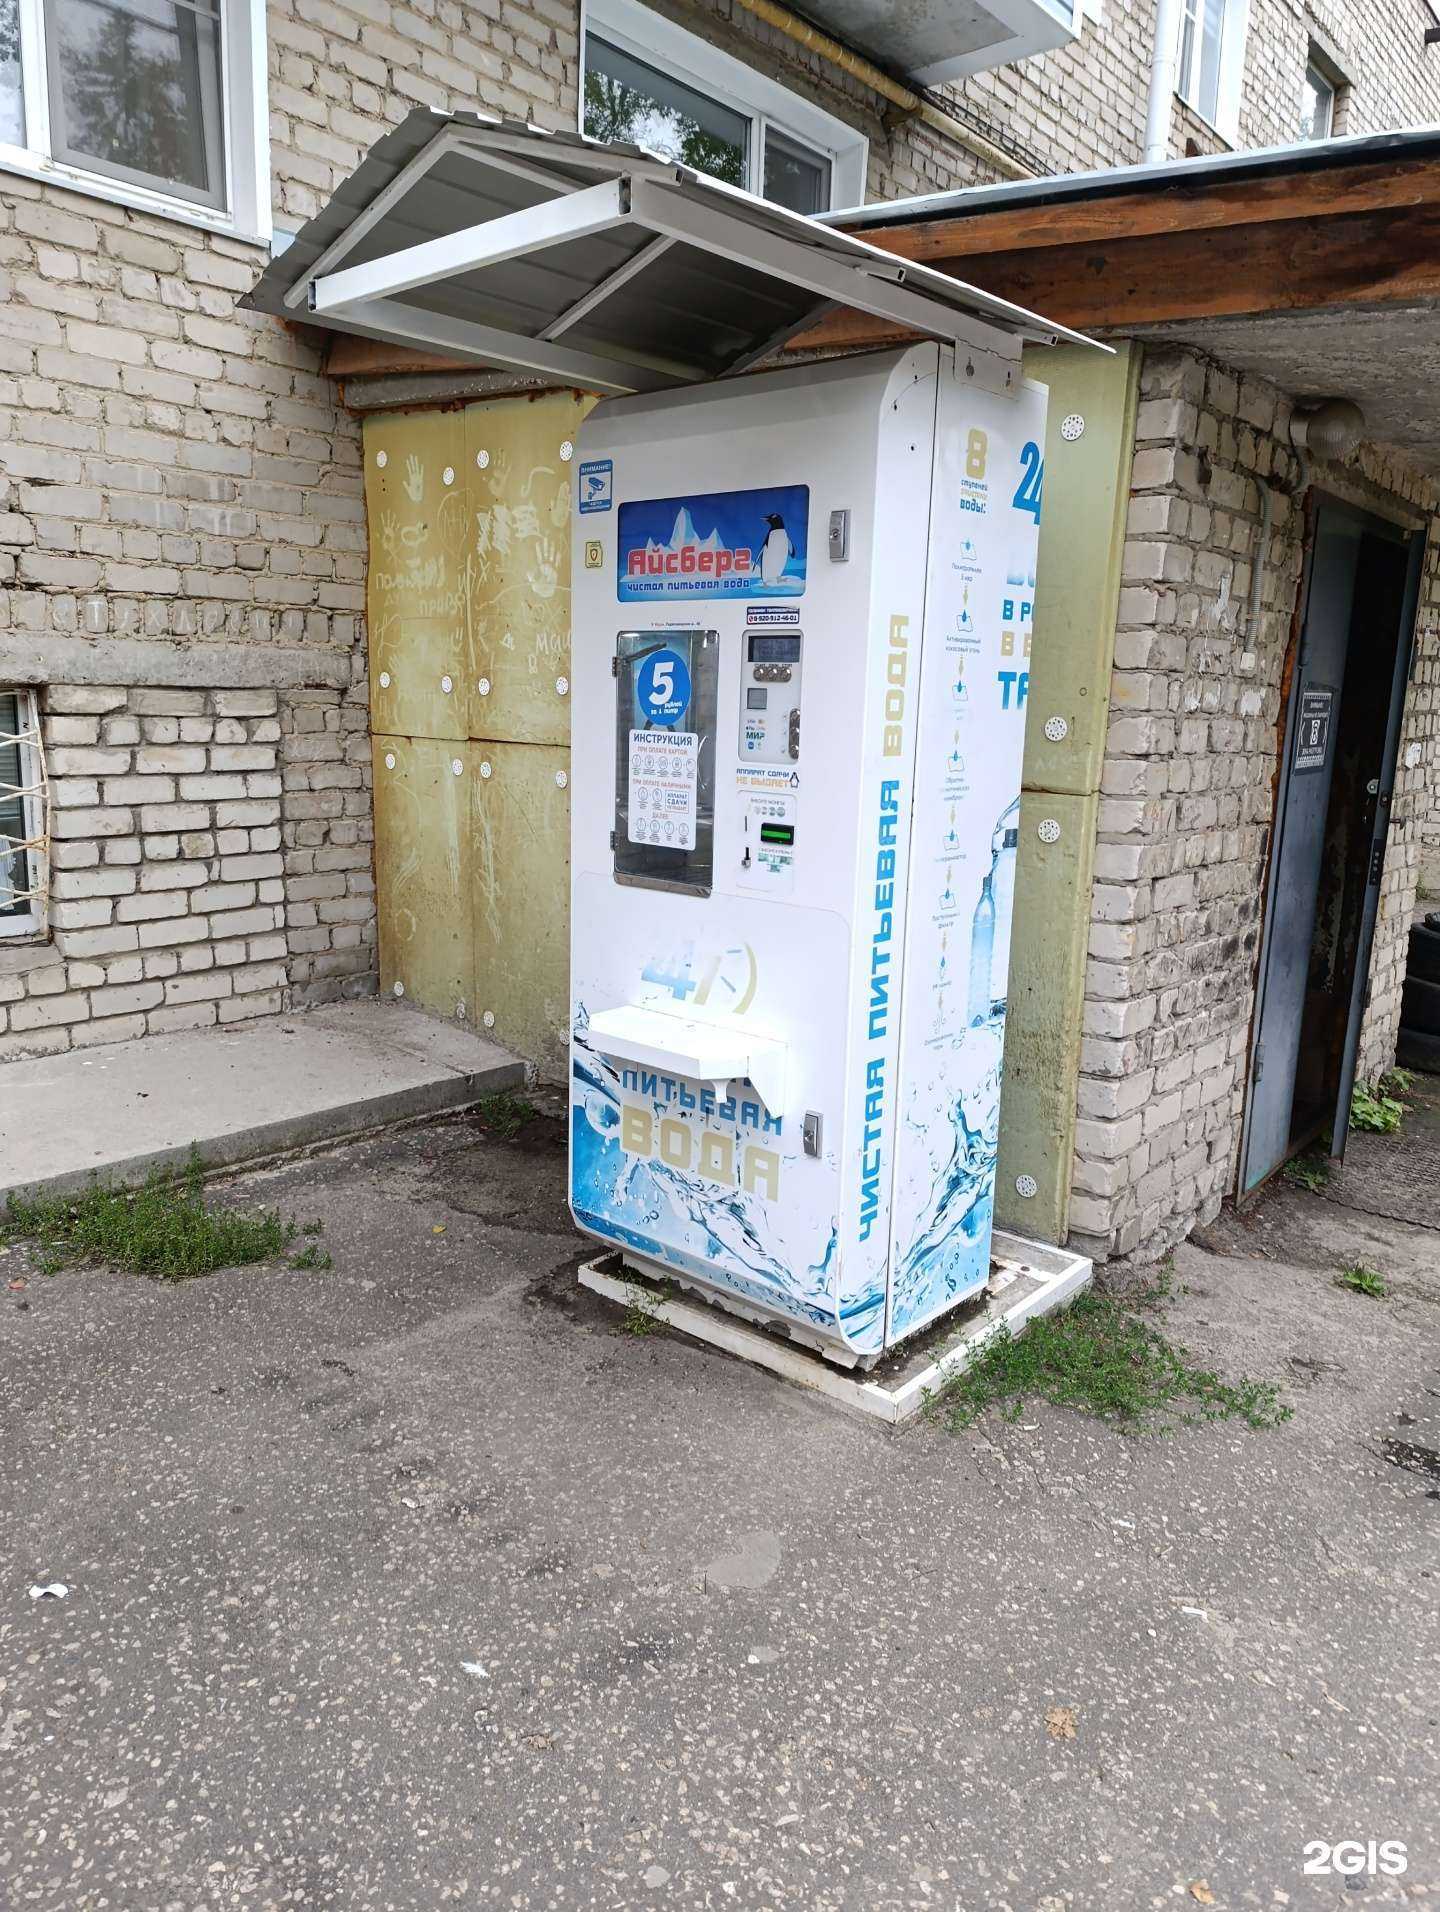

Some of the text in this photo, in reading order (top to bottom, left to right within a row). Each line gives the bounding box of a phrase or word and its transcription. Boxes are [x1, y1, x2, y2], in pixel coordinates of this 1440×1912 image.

[966, 428, 988, 480] 8
[628, 546, 752, 578] Айсберг
[627, 578, 750, 592] чистая питьевая вода
[1002, 599, 1035, 623] В Р
[1000, 631, 1015, 657] В
[649, 661, 675, 705] 5
[634, 733, 693, 747] ИНСТРУКЦИЯ
[859, 614, 909, 1242] ЧИСТАЯ ПИТЬЕВАЯ ВОДА
[622, 1104, 780, 1202] ВОДА
